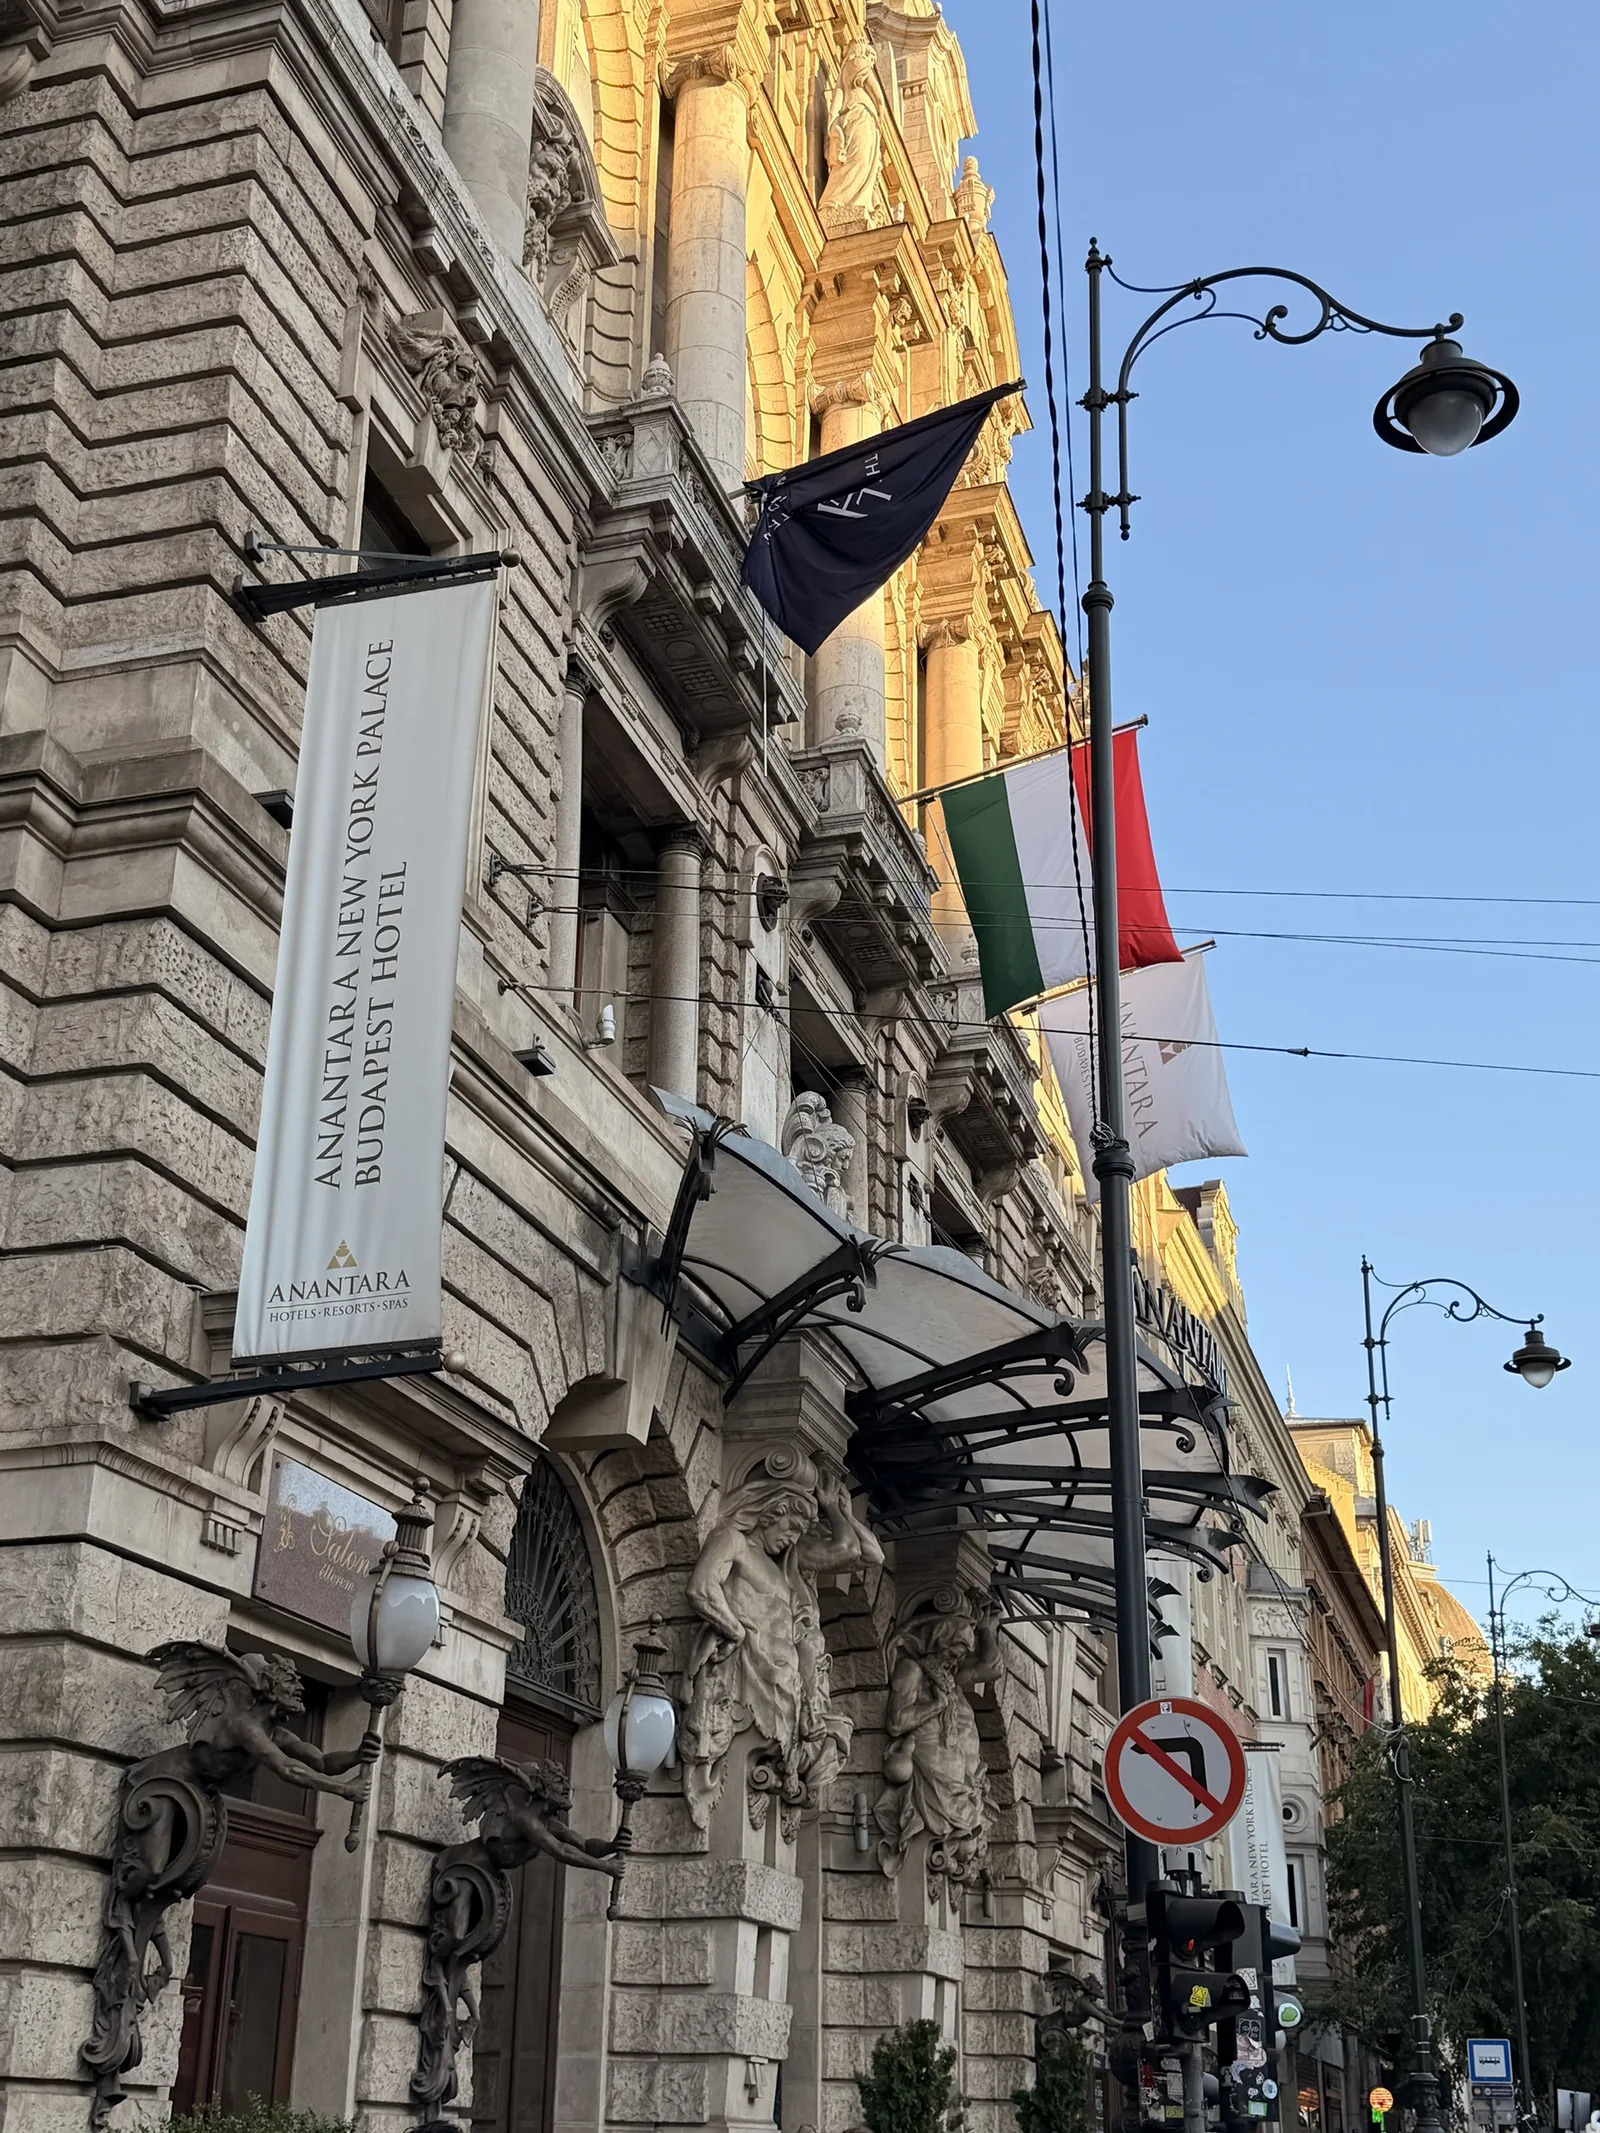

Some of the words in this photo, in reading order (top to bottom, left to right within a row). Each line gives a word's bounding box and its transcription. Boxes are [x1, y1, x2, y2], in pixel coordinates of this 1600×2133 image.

[356, 639, 394, 759] PALACE
[345, 763, 380, 867] YORK
[335, 875, 368, 957] NEW
[371, 861, 408, 985] HOTEL
[314, 967, 360, 1190] ANANTARA
[354, 996, 395, 1189] BUDAPEST
[267, 1269, 411, 1304] ANANTARA
[269, 1308, 316, 1323] HOTELS
[323, 1301, 376, 1318] RESORTS
[382, 1297, 409, 1312] SPAS
[310, 1506, 370, 1578] Salon
[1245, 1809, 1256, 1841] YORK
[1248, 1843, 1258, 1868] NEW
[1259, 1841, 1270, 1878] HOTEL
[1250, 1872, 1260, 1904] TARA
